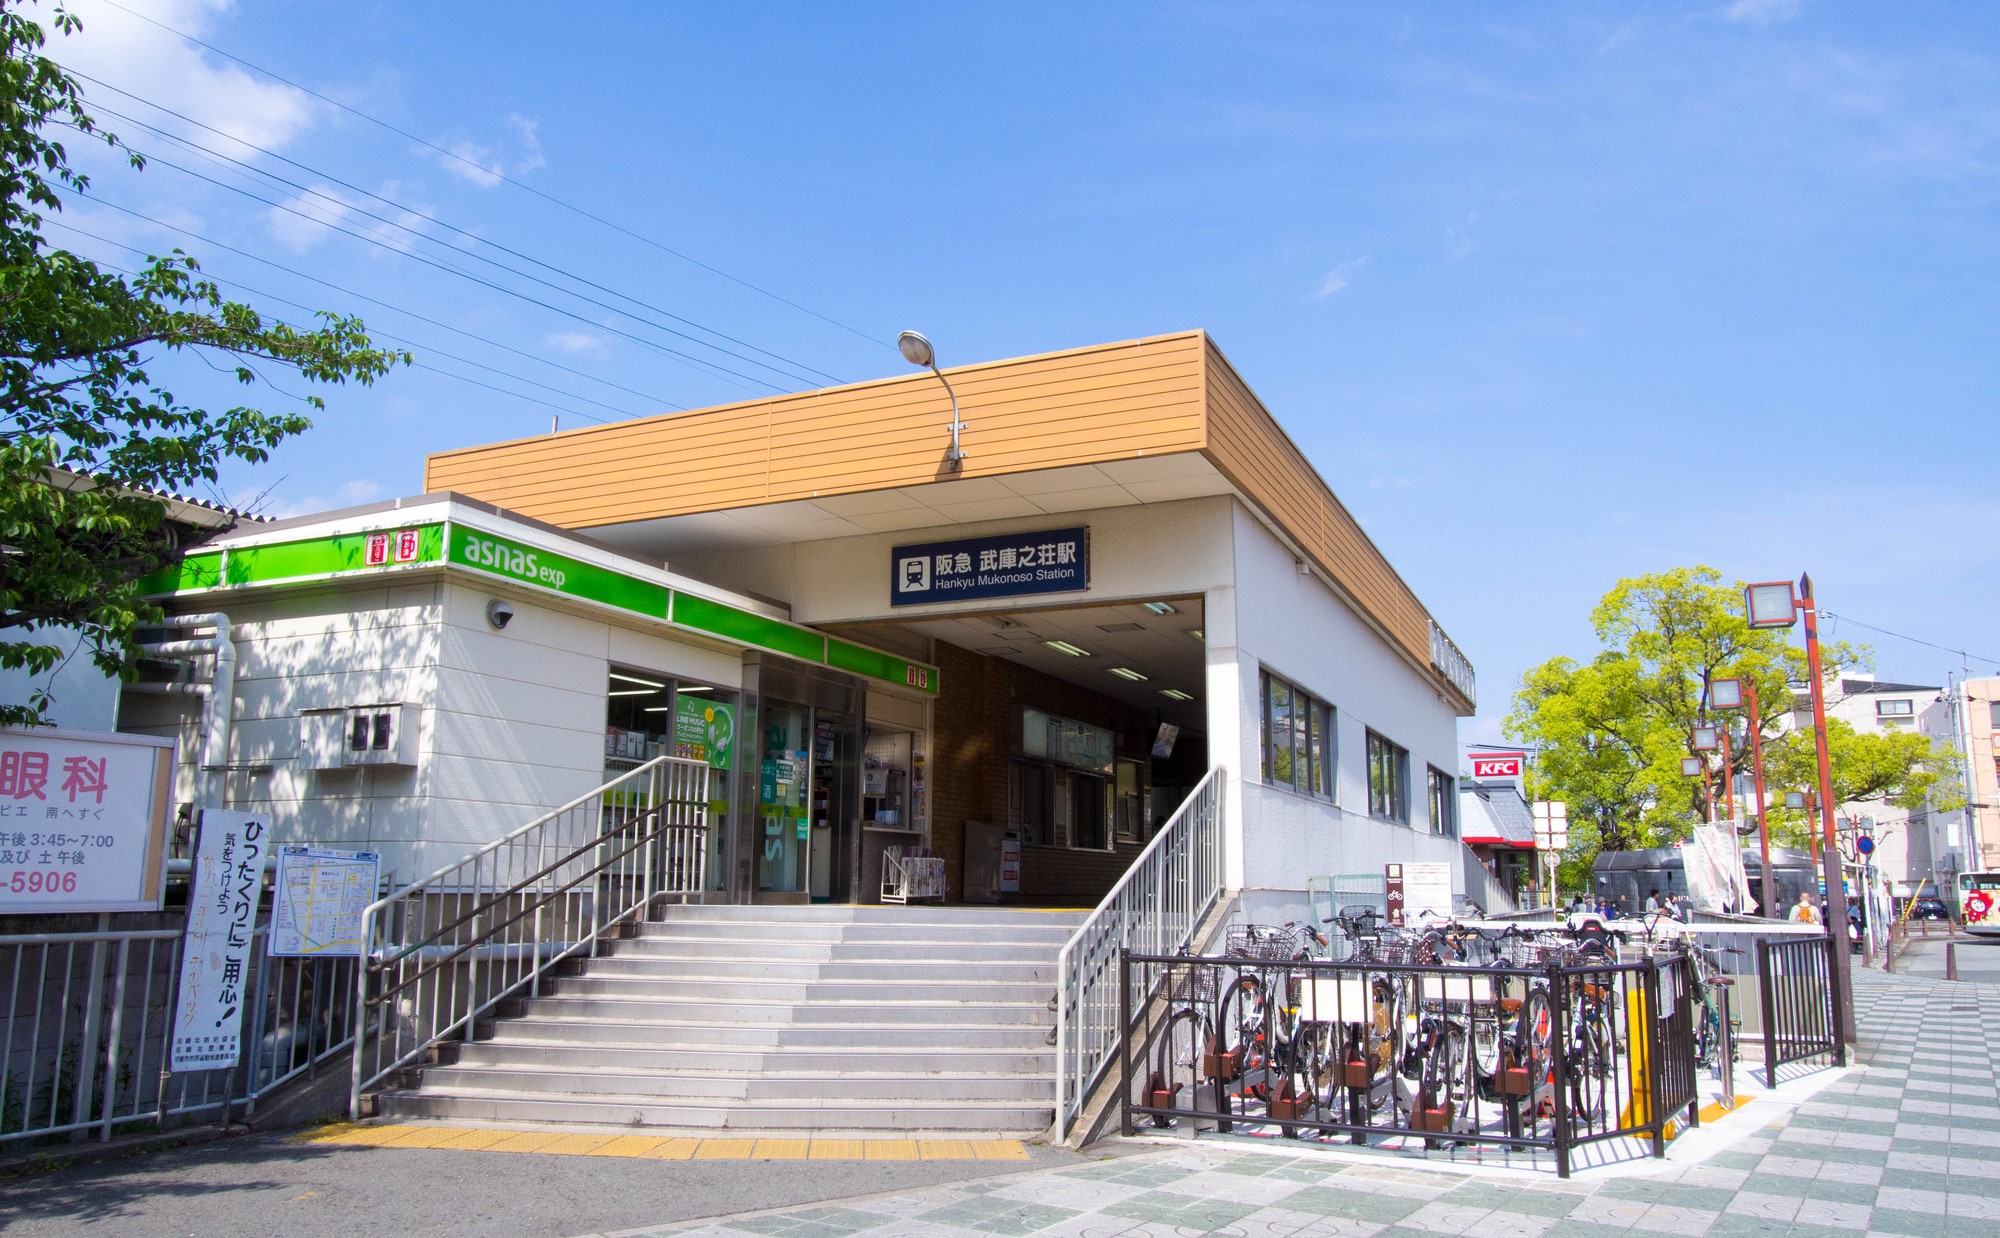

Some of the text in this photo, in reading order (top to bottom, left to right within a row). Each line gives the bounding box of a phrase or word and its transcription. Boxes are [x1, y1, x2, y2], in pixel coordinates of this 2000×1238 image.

[464, 535, 566, 590] asnas exp
[935, 541, 1077, 577] 阪急 武庫之荘駅
[935, 568, 1075, 590] Hankyu Mukonoso Station
[689, 717, 706, 727] MUSIC
[0, 751, 108, 804] 眼科
[1479, 762, 1515, 775] KFC
[0, 850, 85, 866] 及び 土 午後
[217, 832, 237, 915] 気をつけよう
